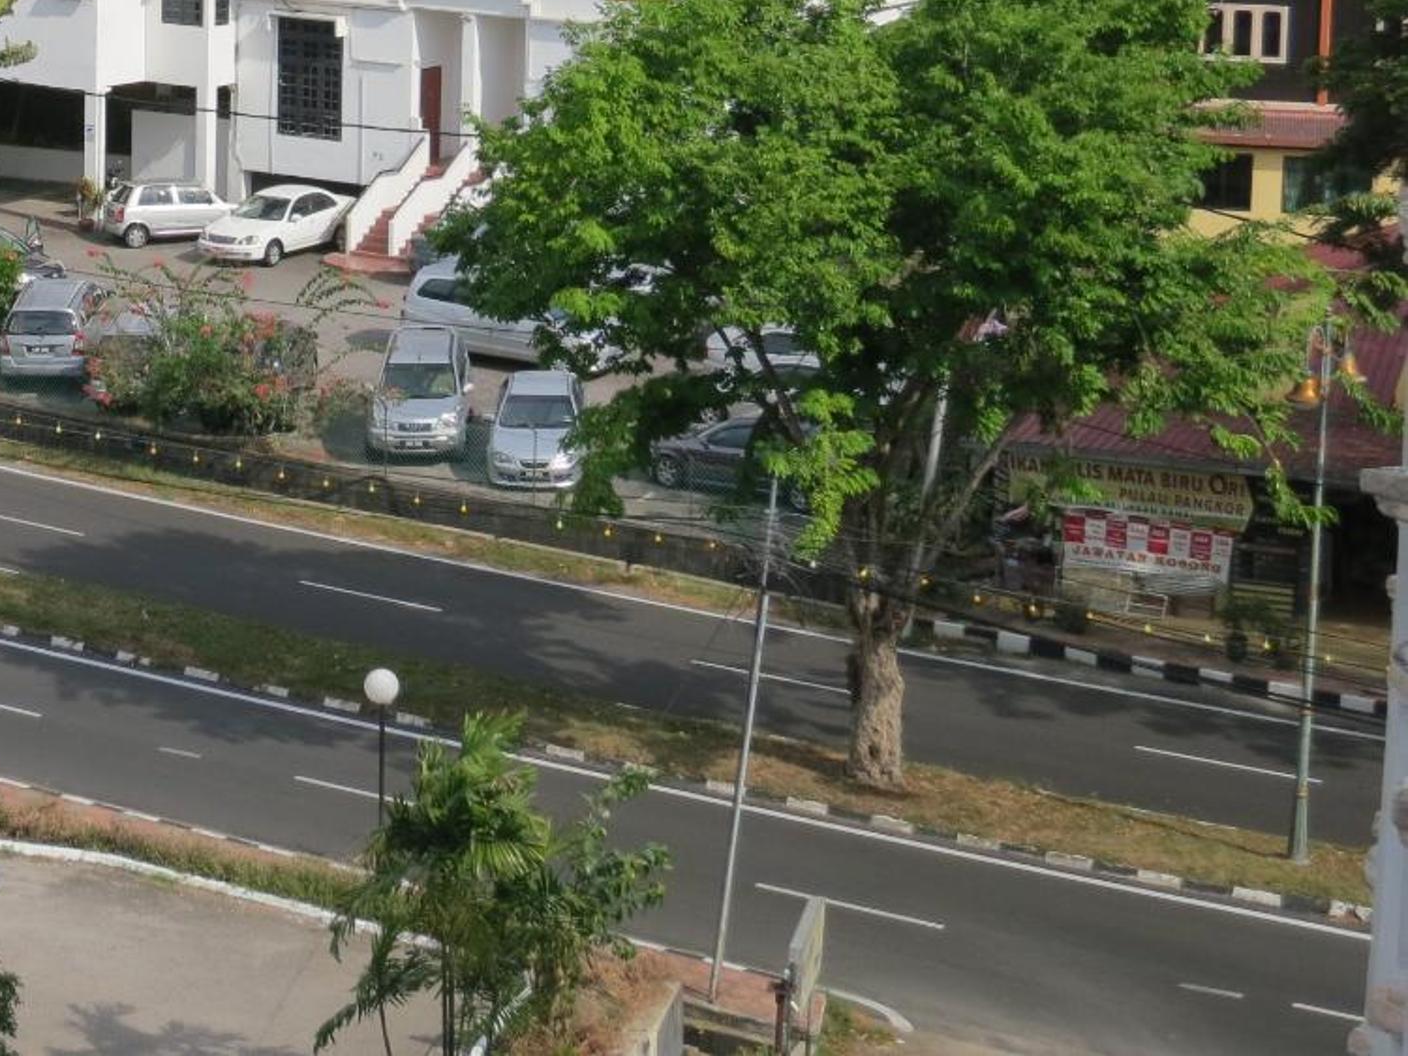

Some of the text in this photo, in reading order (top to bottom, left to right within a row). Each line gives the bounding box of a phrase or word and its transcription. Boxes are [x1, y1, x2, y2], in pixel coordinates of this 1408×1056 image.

[1107, 465, 1156, 488] MATA
[1161, 471, 1204, 492] BIRU
[1174, 494, 1246, 516] PANGKOR
[1072, 545, 1147, 563] JAWATAN
[1155, 555, 1222, 573] KOSONG
